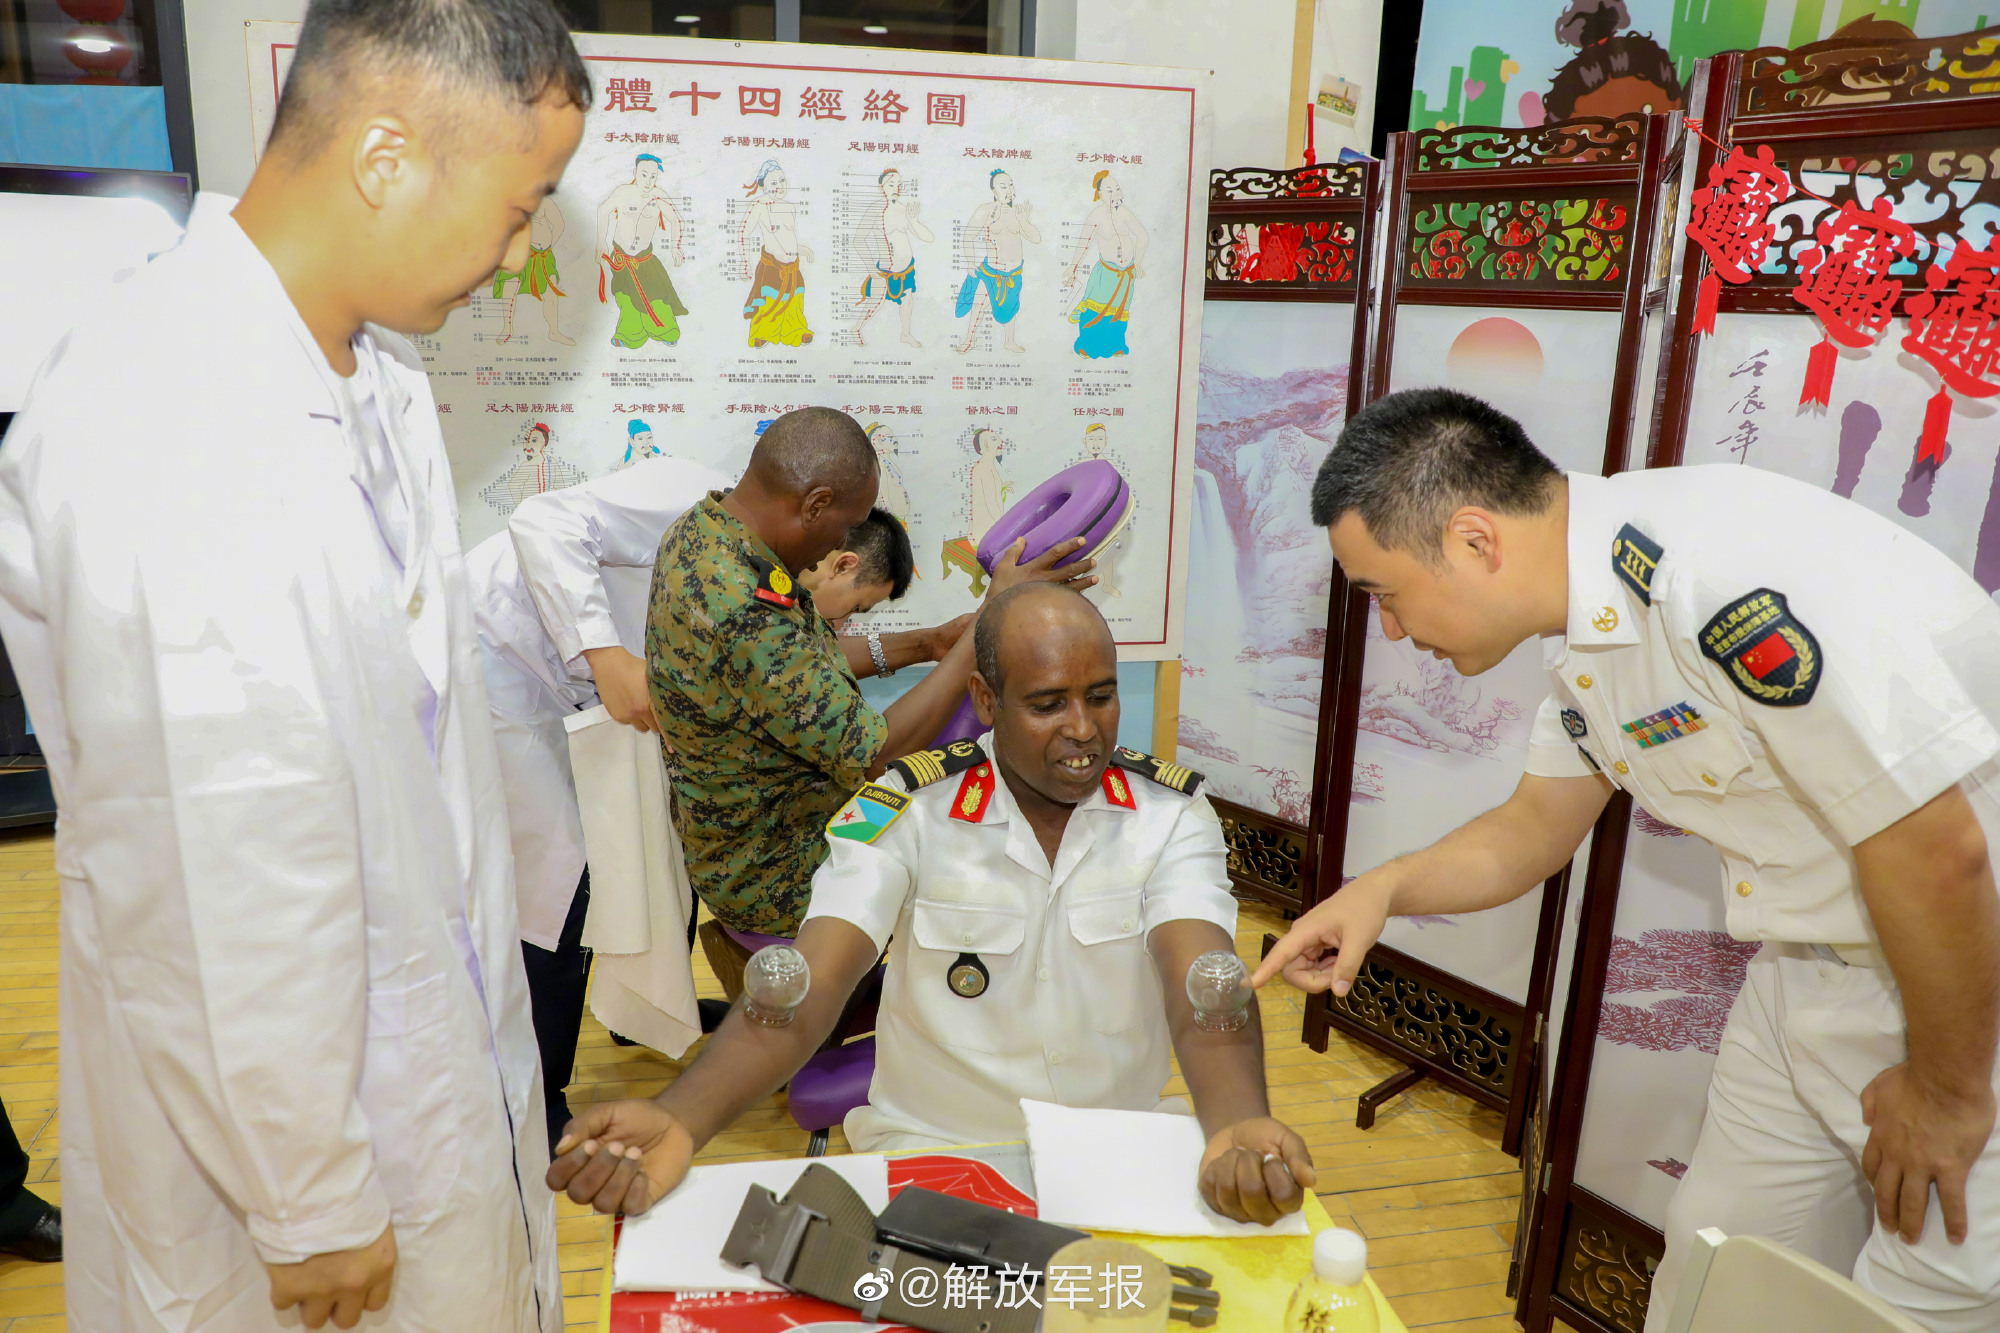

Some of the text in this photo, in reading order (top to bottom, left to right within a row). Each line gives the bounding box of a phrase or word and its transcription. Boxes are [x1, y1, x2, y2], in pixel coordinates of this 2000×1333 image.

[604, 77, 966, 127] 體十四經絡圖
[603, 131, 681, 145] 手太陰肺經
[721, 135, 811, 150] 手陽明大腸經
[848, 141, 920, 155] 足陽明胃經
[962, 147, 1033, 161] 足太陰脾經
[1075, 152, 1143, 166] 手少陰心經
[484, 402, 575, 414] 足太陽膀胱經
[611, 402, 686, 414] 足少陰腎經
[865, 788, 901, 806] DJIBOUTI
